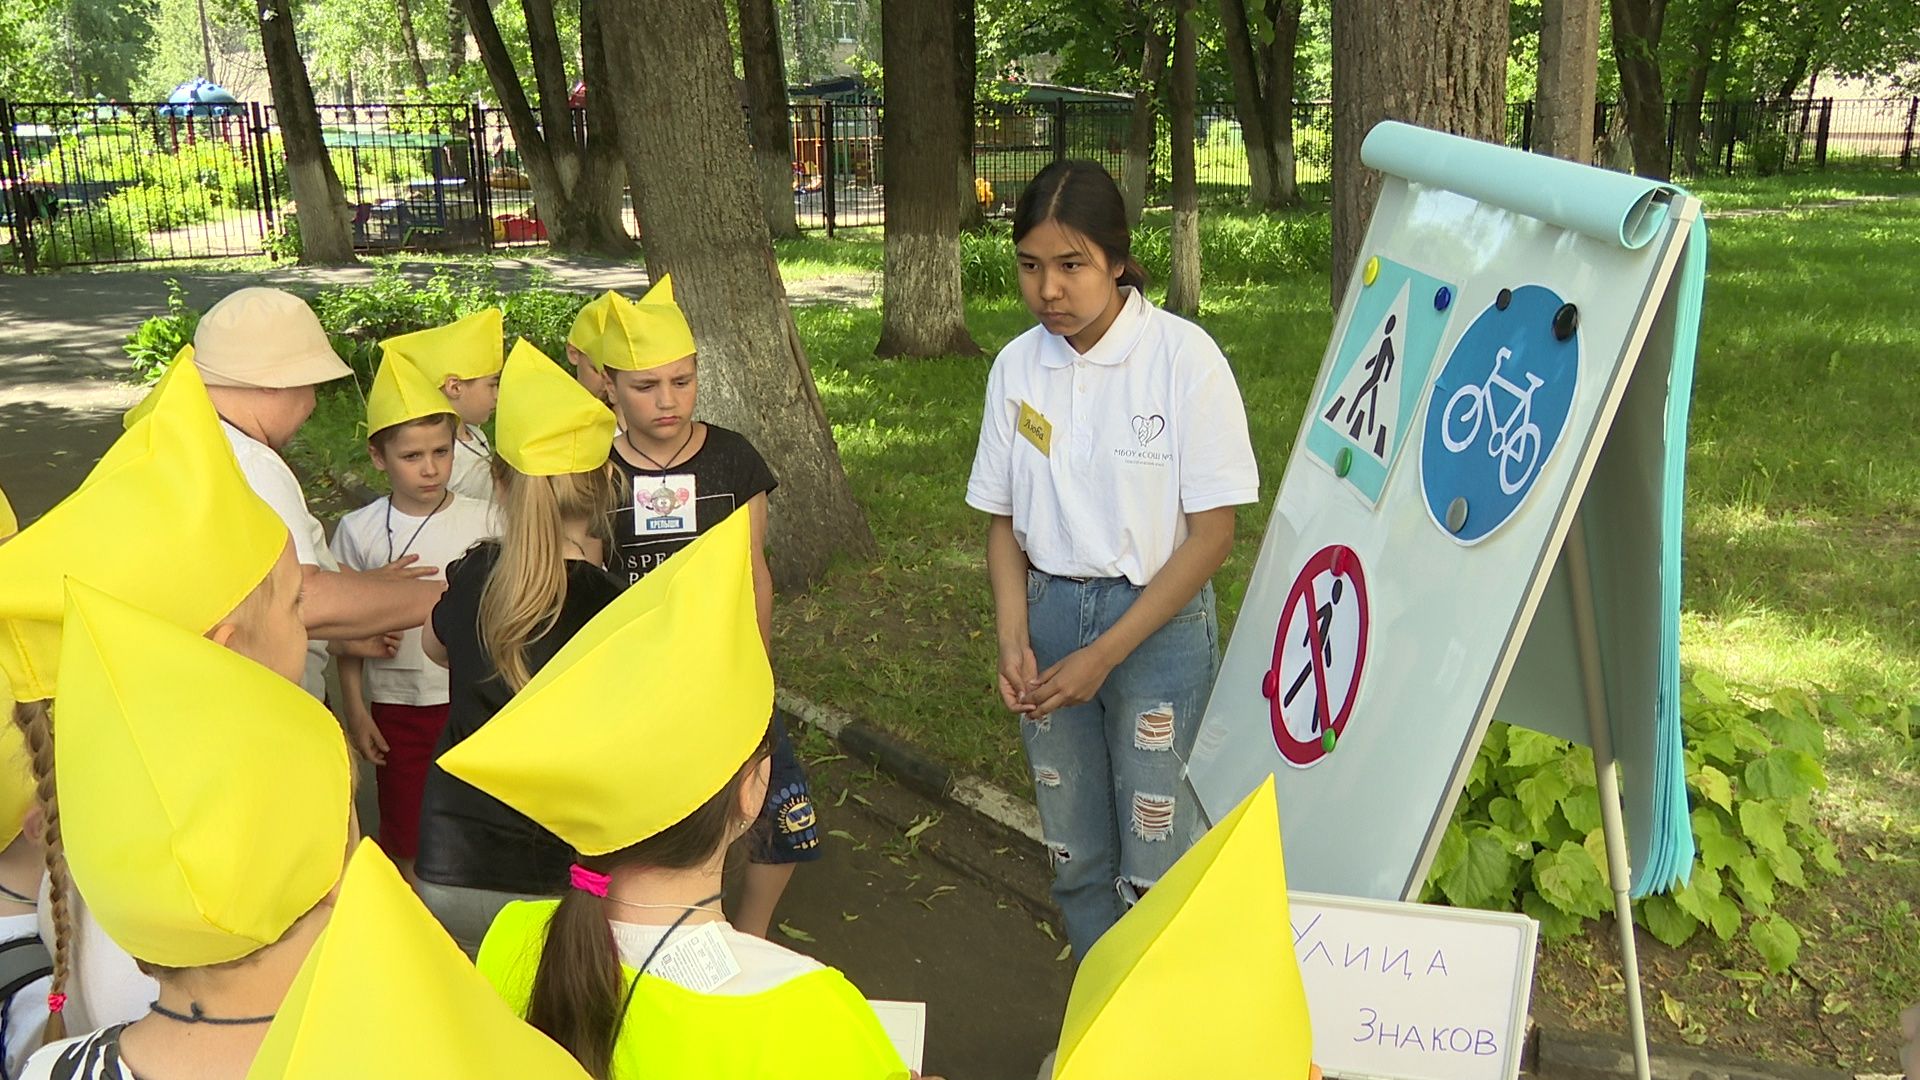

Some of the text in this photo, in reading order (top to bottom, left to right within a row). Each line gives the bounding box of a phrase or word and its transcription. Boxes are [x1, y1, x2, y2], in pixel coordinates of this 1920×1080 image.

[1023, 418, 1044, 441] Люба
[1113, 448, 1137, 458] МБОУ
[627, 551, 677, 569] SPE
[1353, 1007, 1498, 1056] ЗНАКОВ
